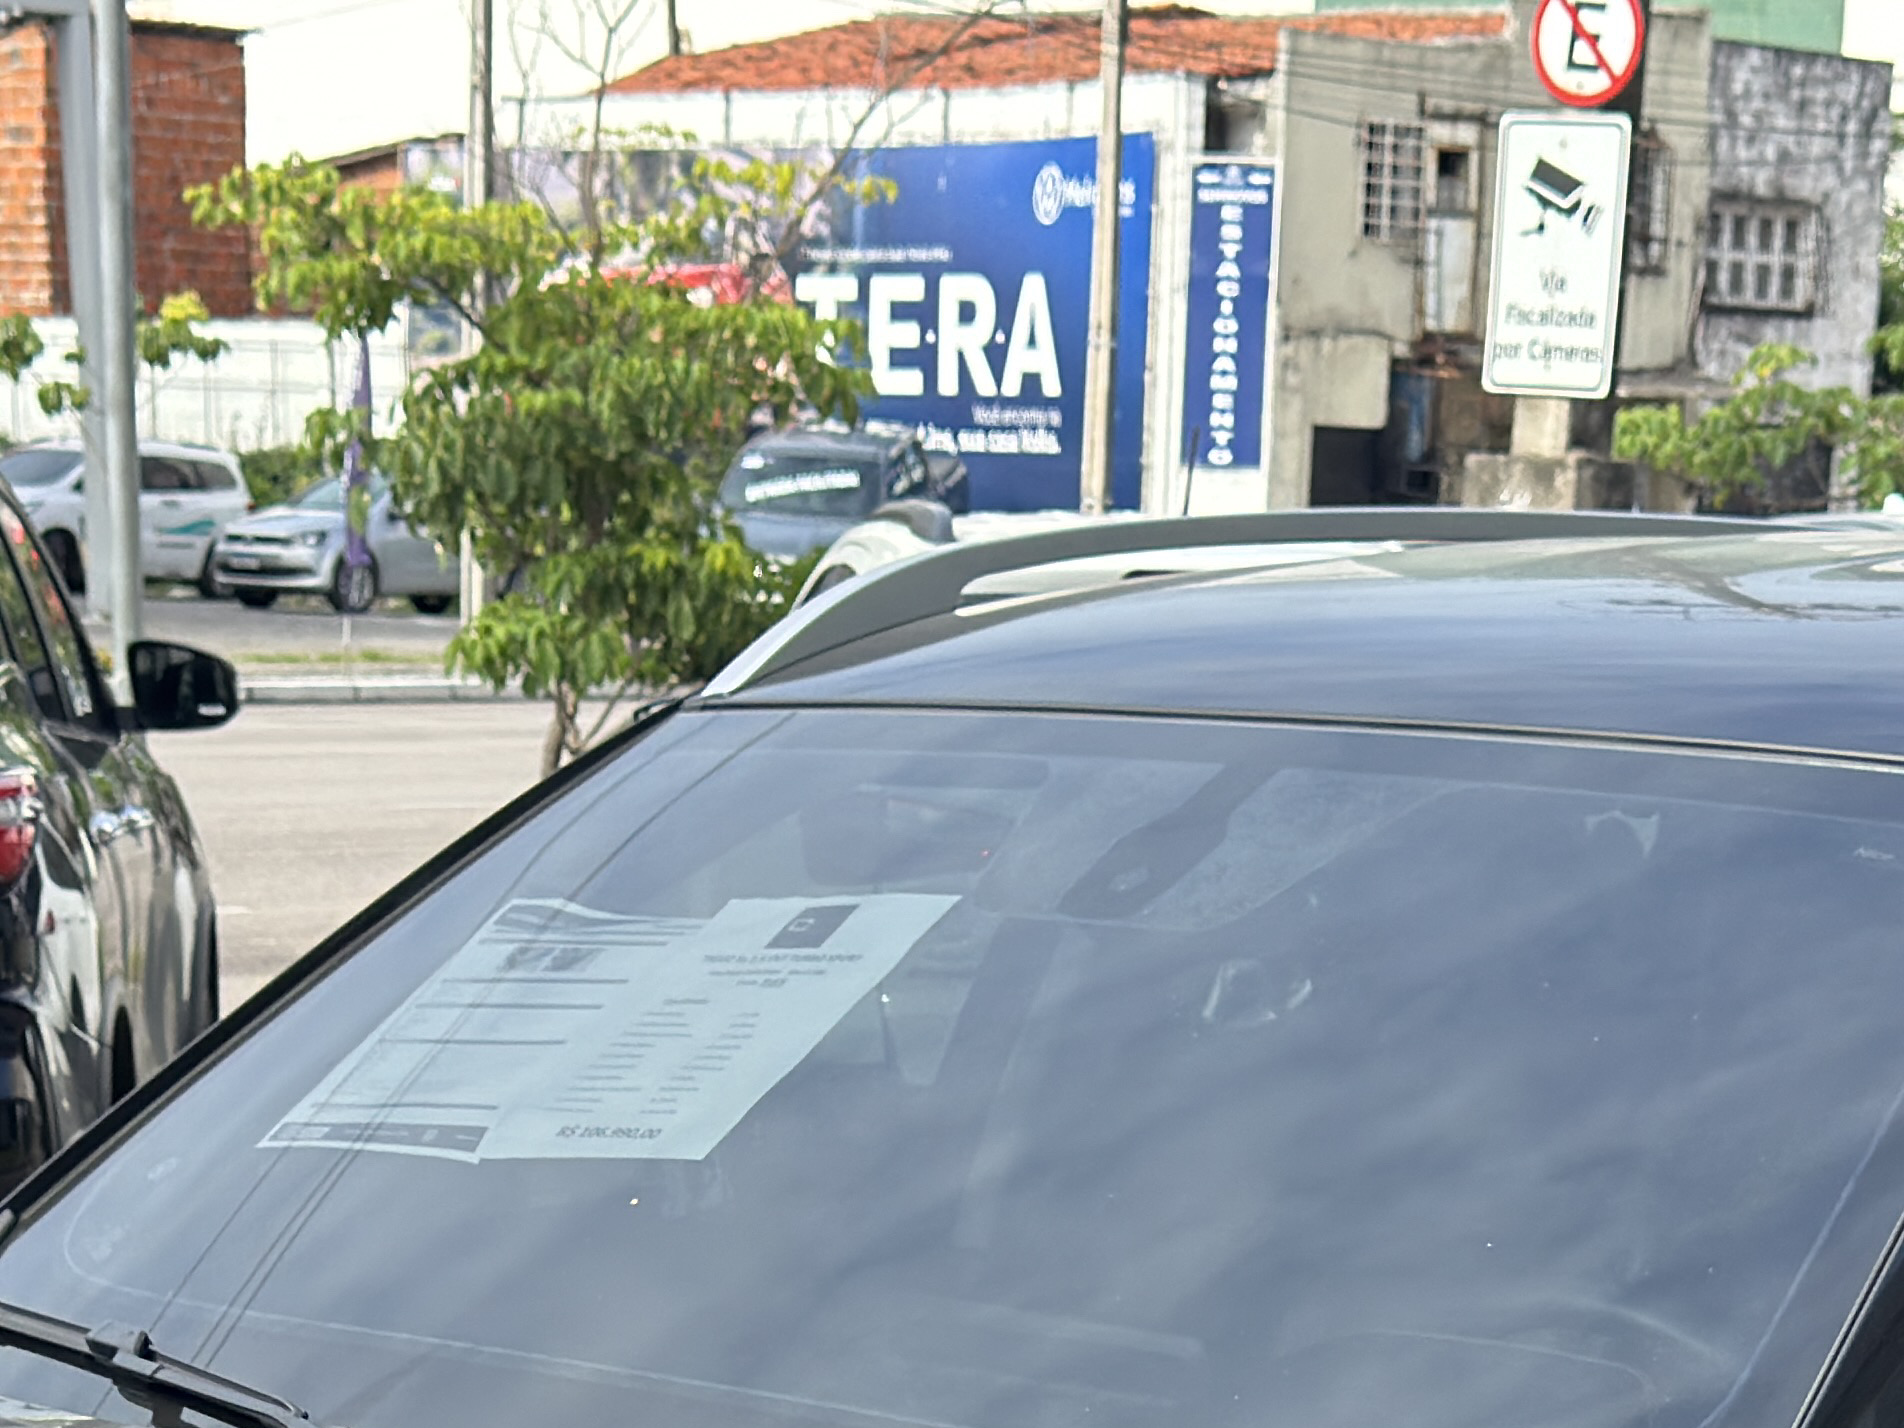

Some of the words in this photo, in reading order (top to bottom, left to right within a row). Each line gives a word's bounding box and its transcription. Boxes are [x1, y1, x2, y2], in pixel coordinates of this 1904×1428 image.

[1566, 2, 1607, 71] E
[795, 271, 1062, 398] TERA
[1207, 204, 1244, 466] ESTACIONAMENTO
